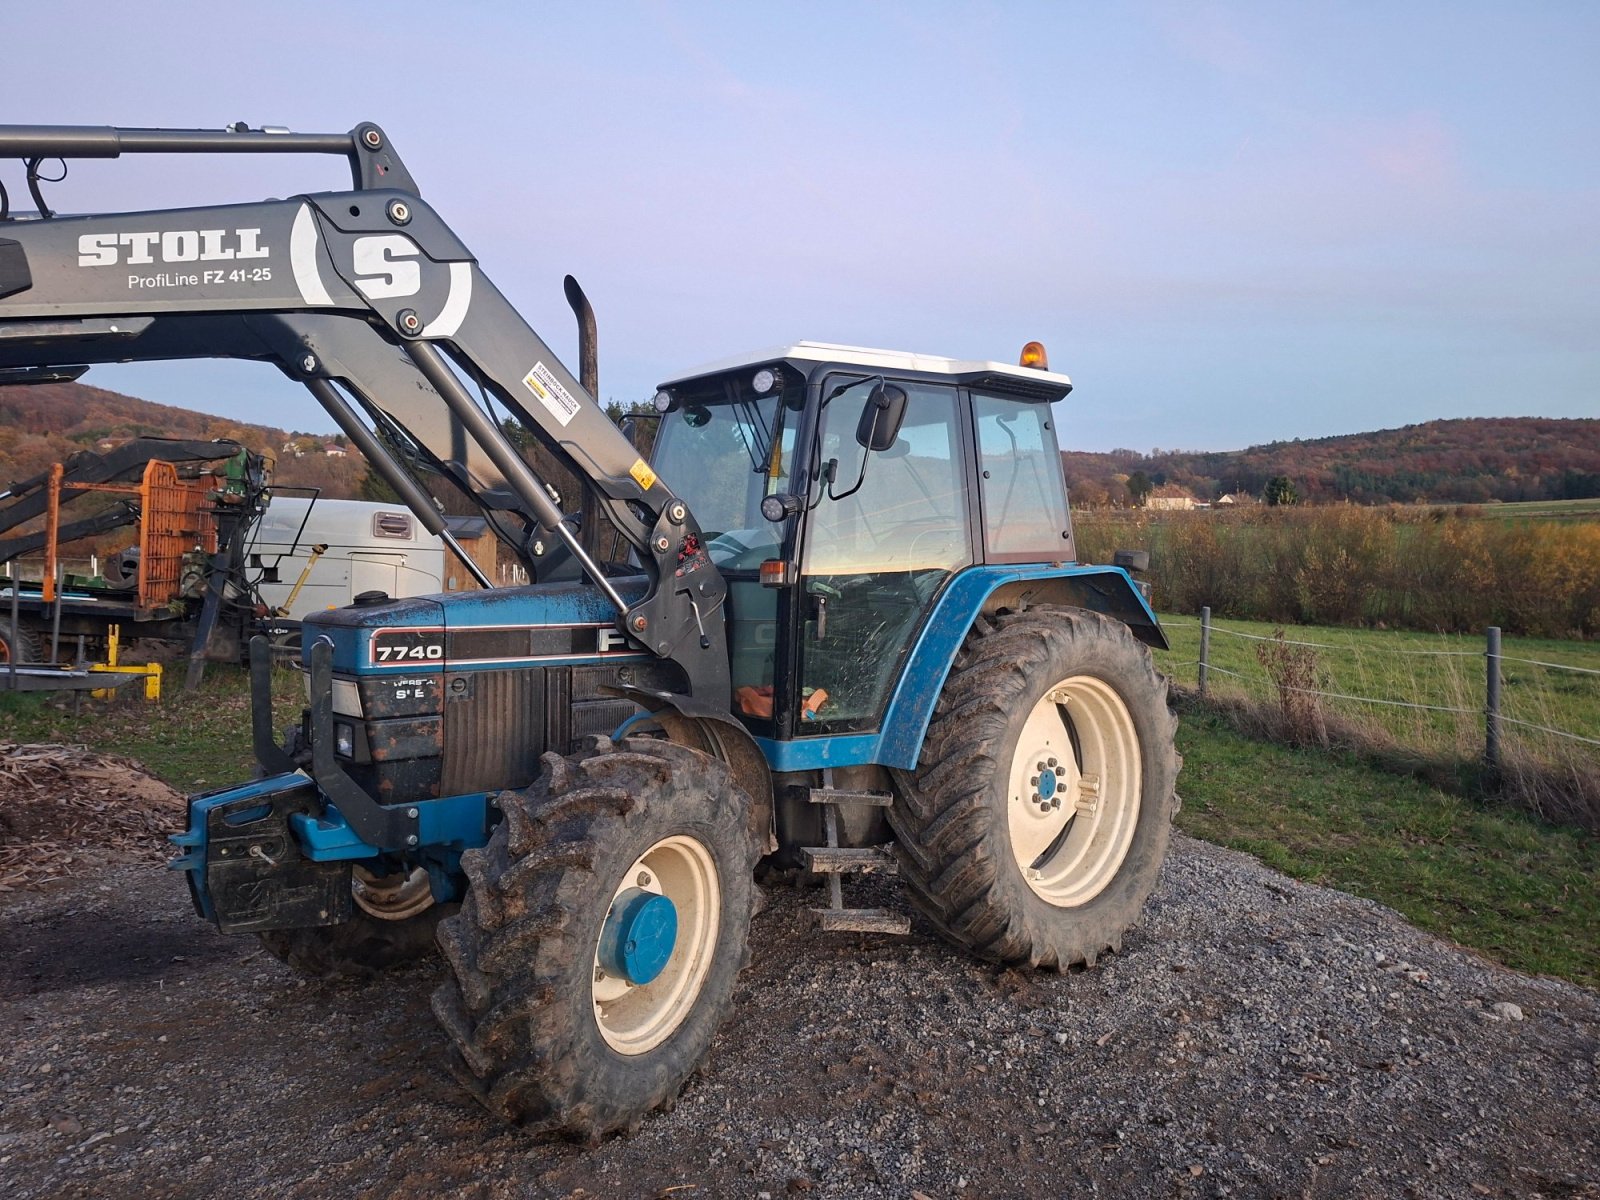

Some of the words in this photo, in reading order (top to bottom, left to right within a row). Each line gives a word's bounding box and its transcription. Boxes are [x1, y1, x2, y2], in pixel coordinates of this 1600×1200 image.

[78, 228, 269, 267] STOLL
[128, 273, 199, 289] ProfiLine
[203, 270, 225, 284] FZ
[229, 267, 272, 282] 41-25
[353, 235, 420, 299] S
[599, 629, 641, 652] F
[376, 644, 443, 661] 7740
